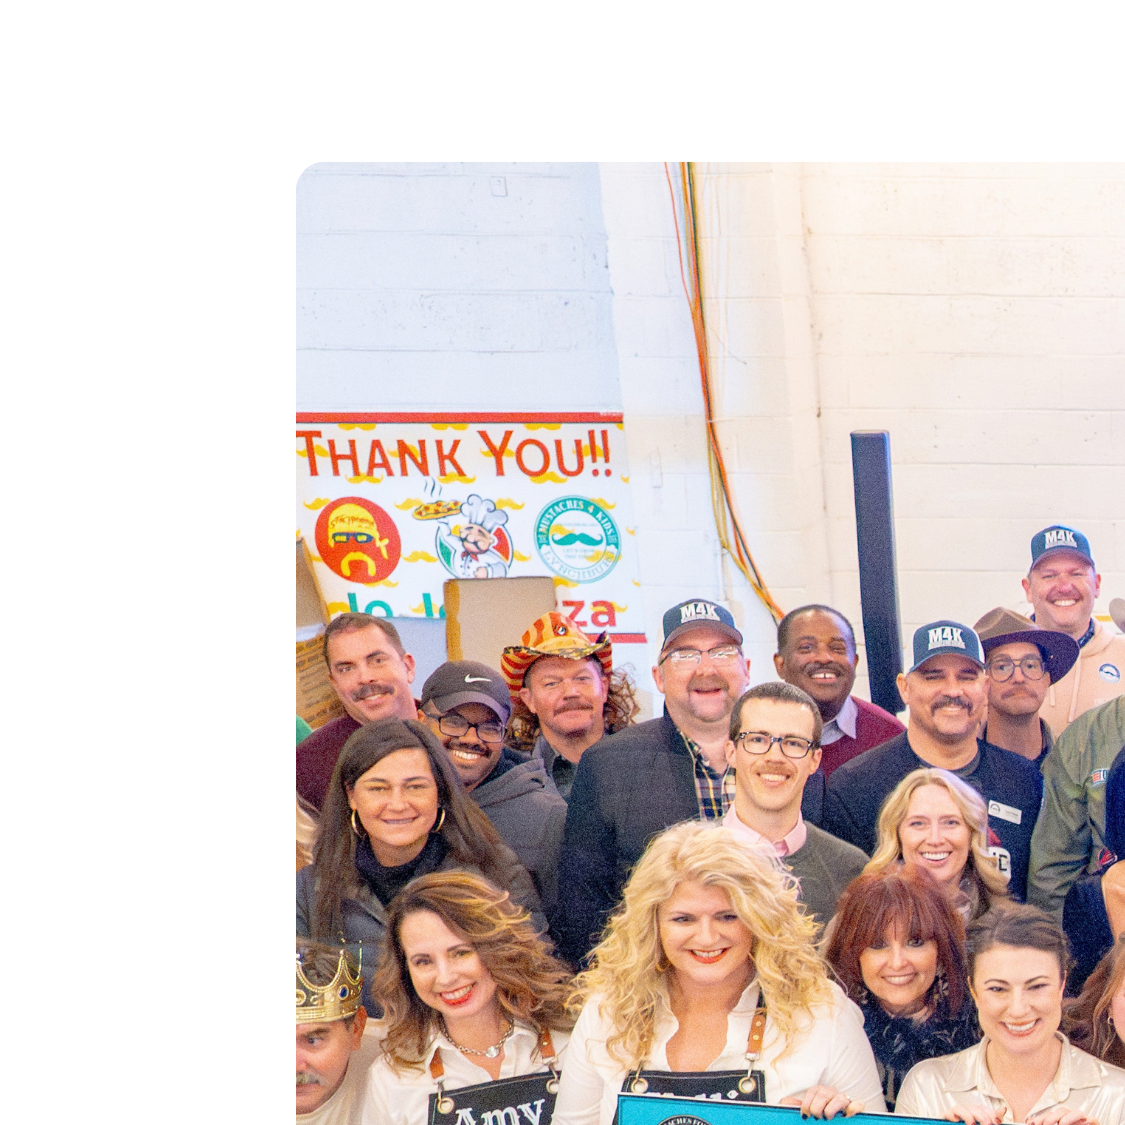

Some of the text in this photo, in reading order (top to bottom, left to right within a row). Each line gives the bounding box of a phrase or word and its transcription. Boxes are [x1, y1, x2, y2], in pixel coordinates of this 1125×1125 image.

[295, 429, 612, 477] THANK YOU!!
[539, 500, 615, 537] MUSTACHES 4 KIDS
[1045, 530, 1076, 545] M4K
[680, 602, 719, 620] M4K
[928, 626, 964, 644] M4K
